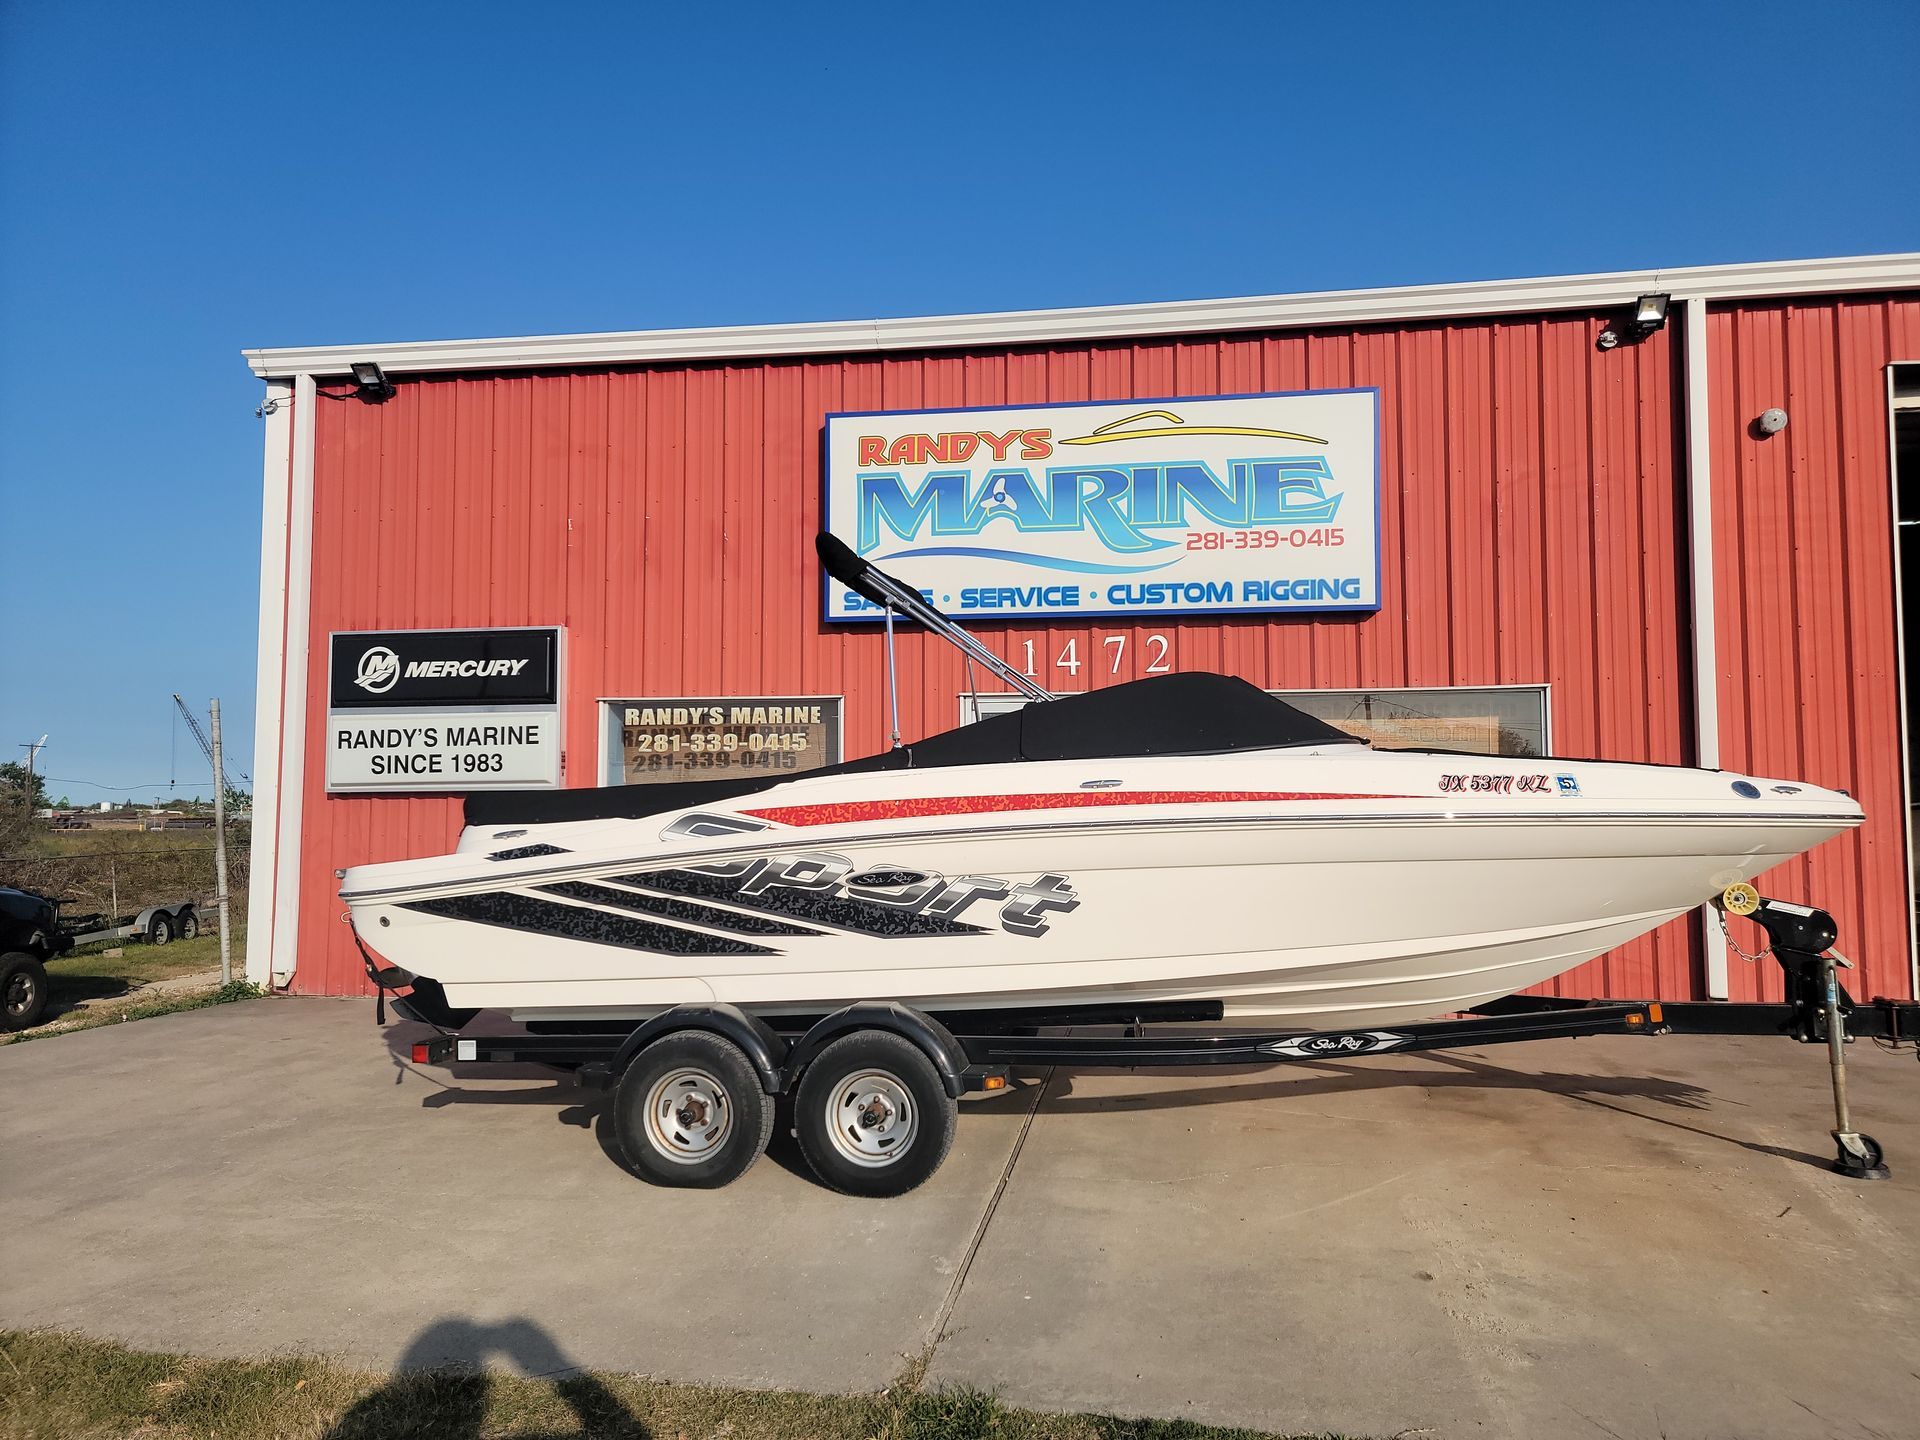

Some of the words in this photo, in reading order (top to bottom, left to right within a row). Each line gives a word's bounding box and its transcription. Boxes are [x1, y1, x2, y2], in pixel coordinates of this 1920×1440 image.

[858, 429, 1053, 466] RANDYS
[856, 456, 1344, 557] MARINE
[1186, 529, 1345, 550] 281-339-0415
[960, 586, 1080, 609] SERVICE
[1107, 581, 1233, 605] CUSTOM
[1243, 578, 1360, 601] RIGGING
[1022, 634, 1171, 676] 1472
[404, 659, 529, 678] MERCURY
[625, 706, 724, 726] RANDY'S
[730, 706, 821, 725] MARINE
[337, 728, 438, 750] RANDY'S
[446, 726, 540, 746] MARINE
[638, 732, 807, 752] 281-339-0415
[371, 754, 443, 775] SINCE
[451, 753, 503, 773] 1983
[1470, 774, 1514, 794] 5377
[857, 874, 883, 884] Sea
[888, 871, 916, 884] Ray
[1311, 1038, 1337, 1049] Sea
[1338, 1036, 1364, 1050] Ray
